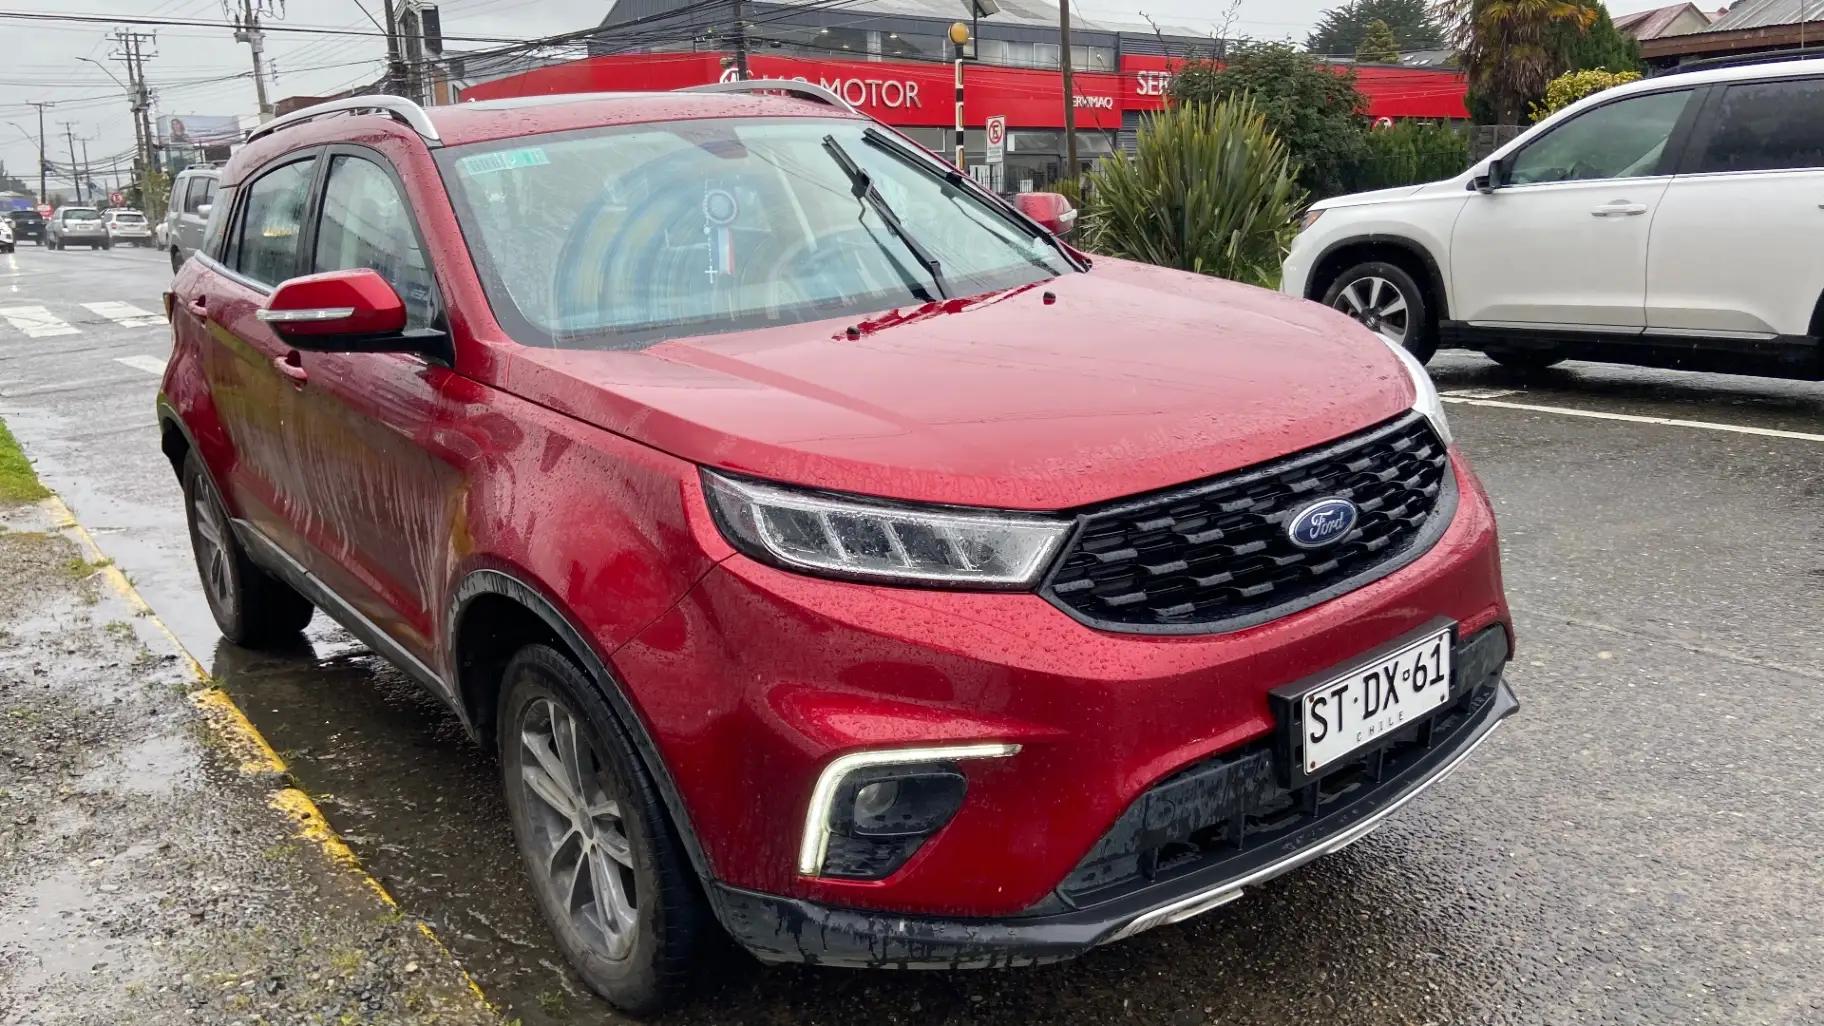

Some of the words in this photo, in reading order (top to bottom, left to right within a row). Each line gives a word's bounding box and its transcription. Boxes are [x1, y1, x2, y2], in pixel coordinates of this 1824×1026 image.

[820, 76, 922, 108] MOTOR
[1310, 509, 1344, 540] Ford
[1356, 711, 1404, 742] CHILE
